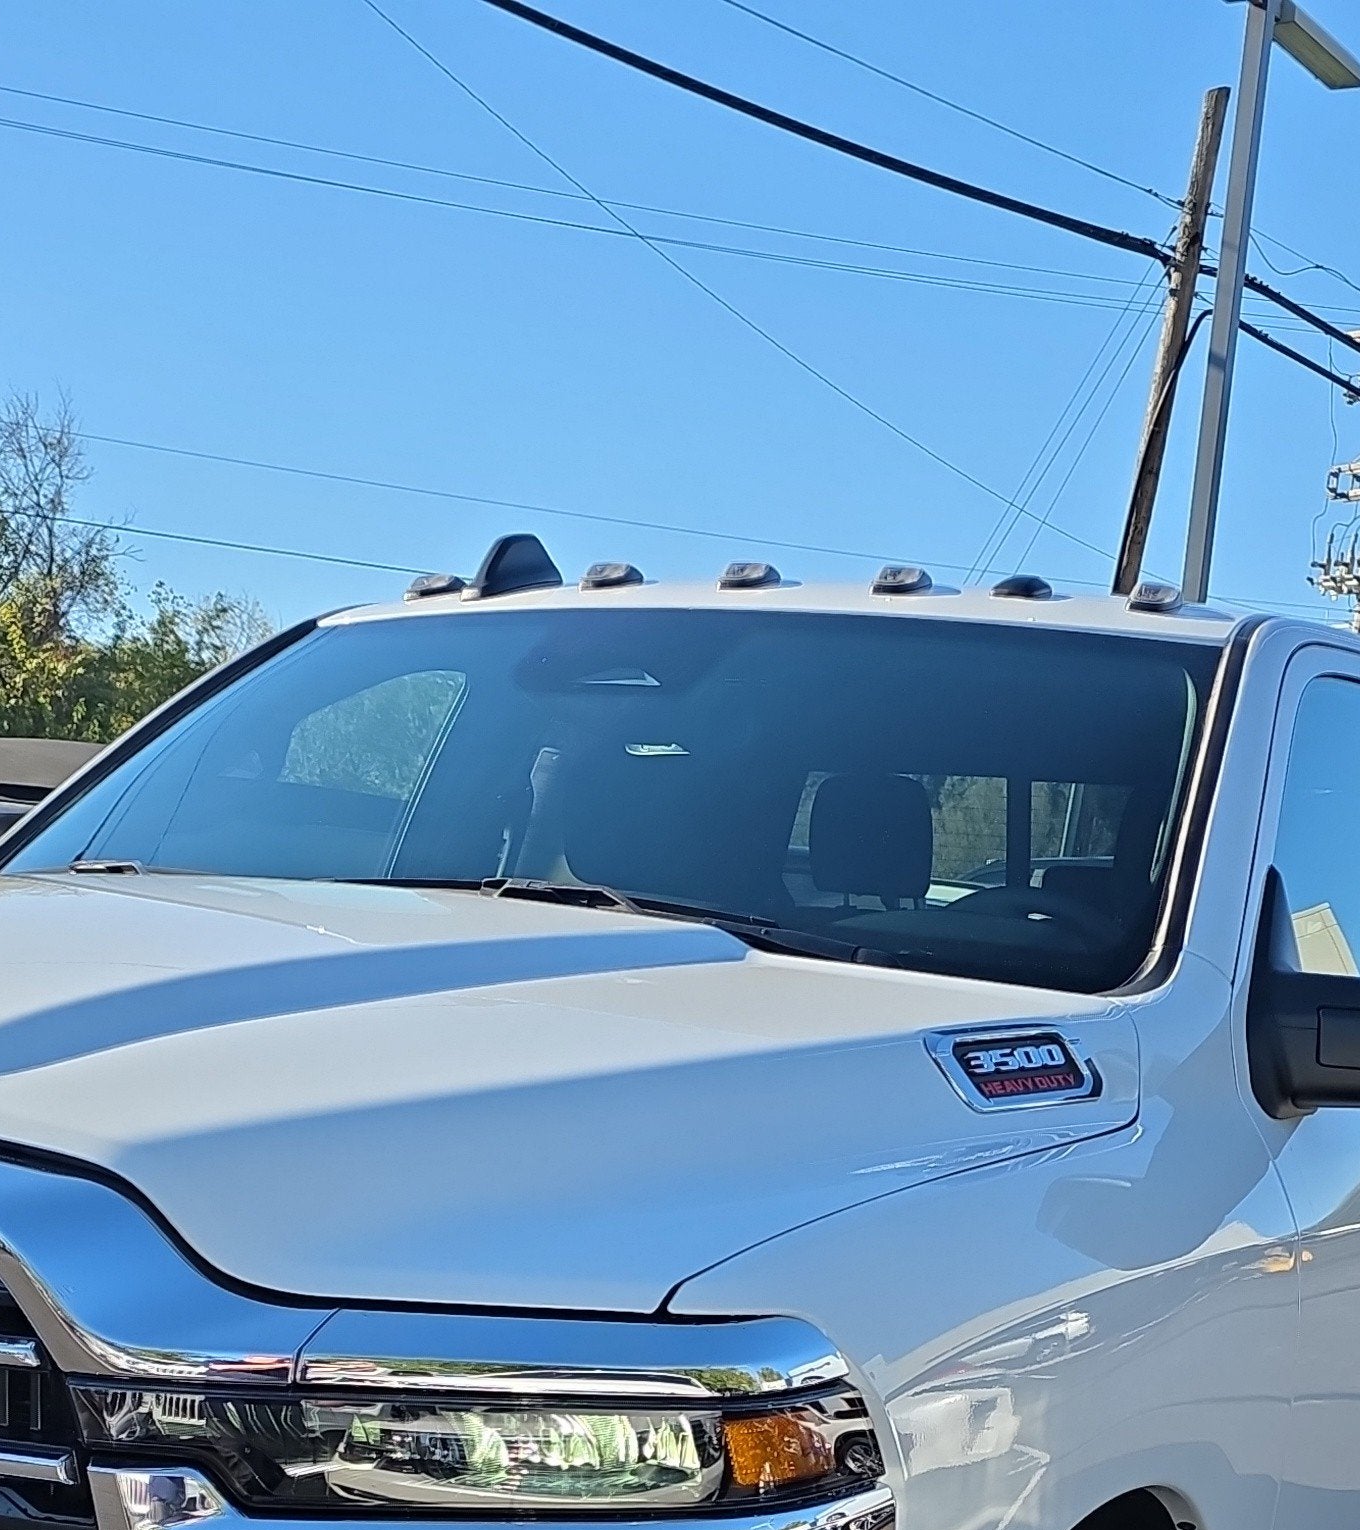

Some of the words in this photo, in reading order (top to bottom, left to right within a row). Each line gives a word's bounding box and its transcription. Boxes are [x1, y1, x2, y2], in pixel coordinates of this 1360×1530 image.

[967, 1044, 1066, 1074] 3500
[981, 1077, 1034, 1096] HEAVY
[1035, 1073, 1075, 1089] DUTY
